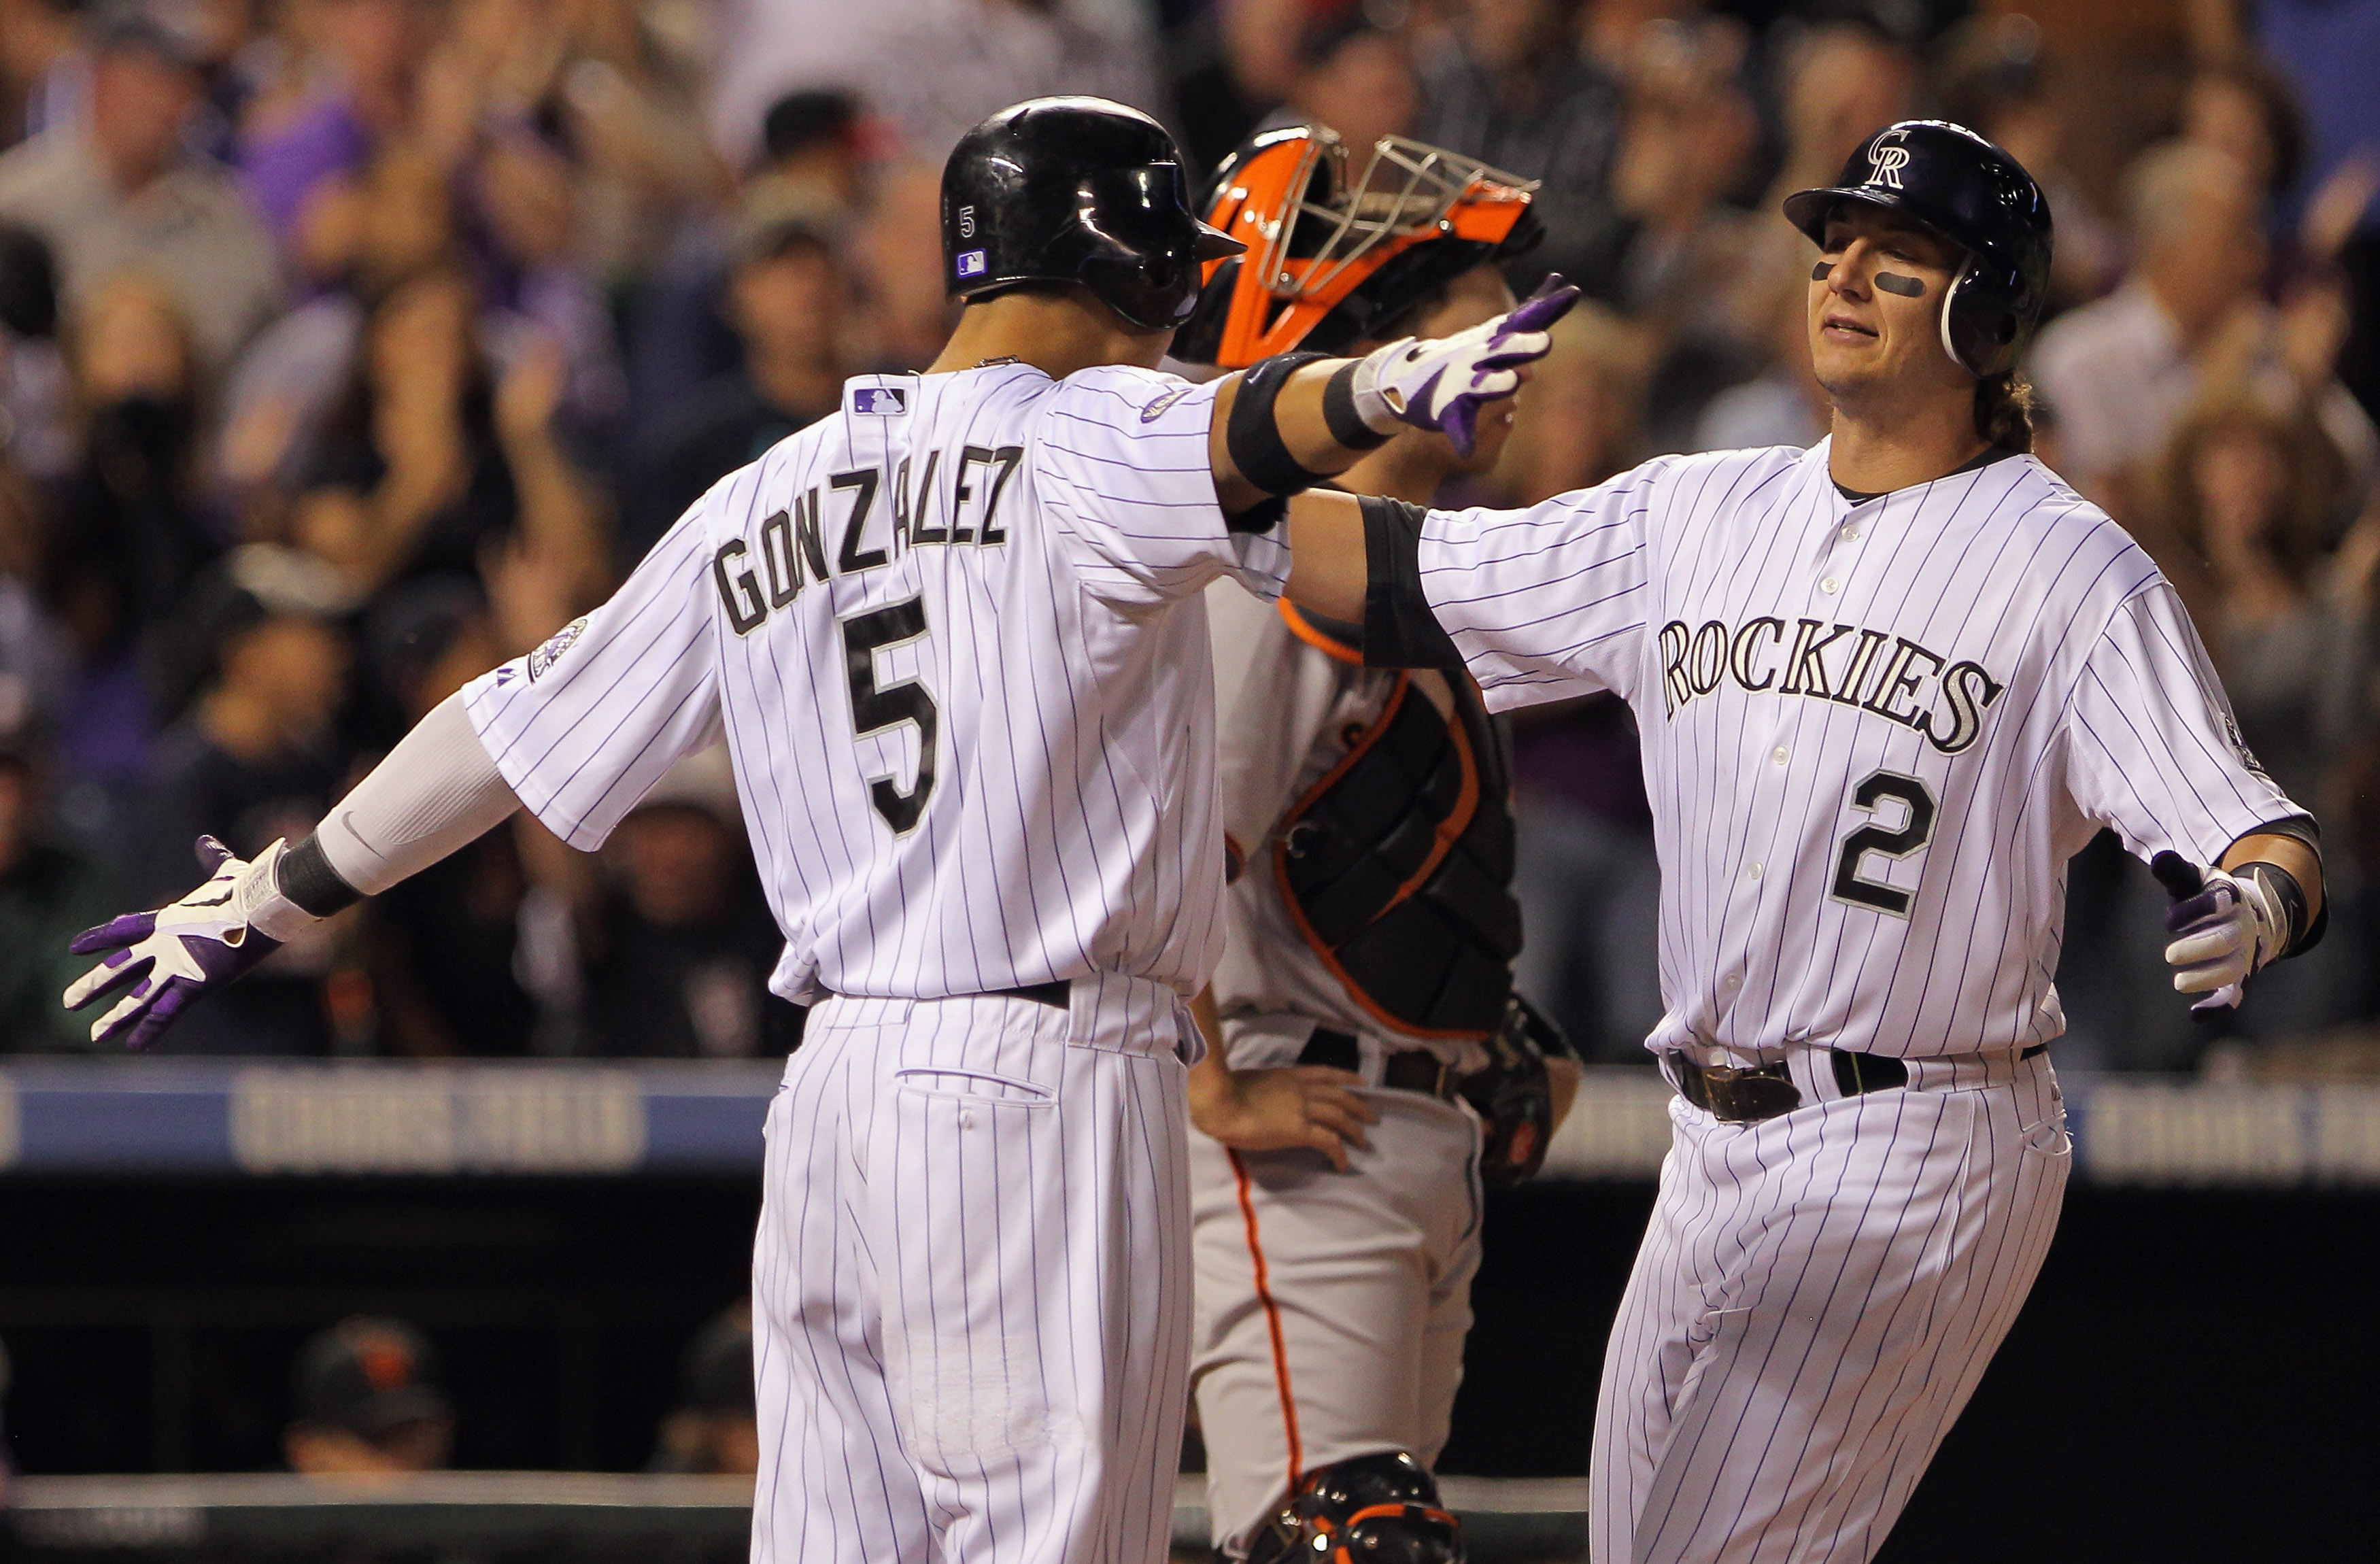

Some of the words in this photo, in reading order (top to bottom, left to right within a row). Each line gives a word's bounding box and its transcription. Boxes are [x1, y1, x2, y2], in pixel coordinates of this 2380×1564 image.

[959, 205, 974, 238] 5
[713, 443, 1025, 638] GONZALEZ
[836, 593, 940, 840] 5
[1657, 615, 2009, 757] ROCKIES
[1828, 767, 1940, 921] 2
